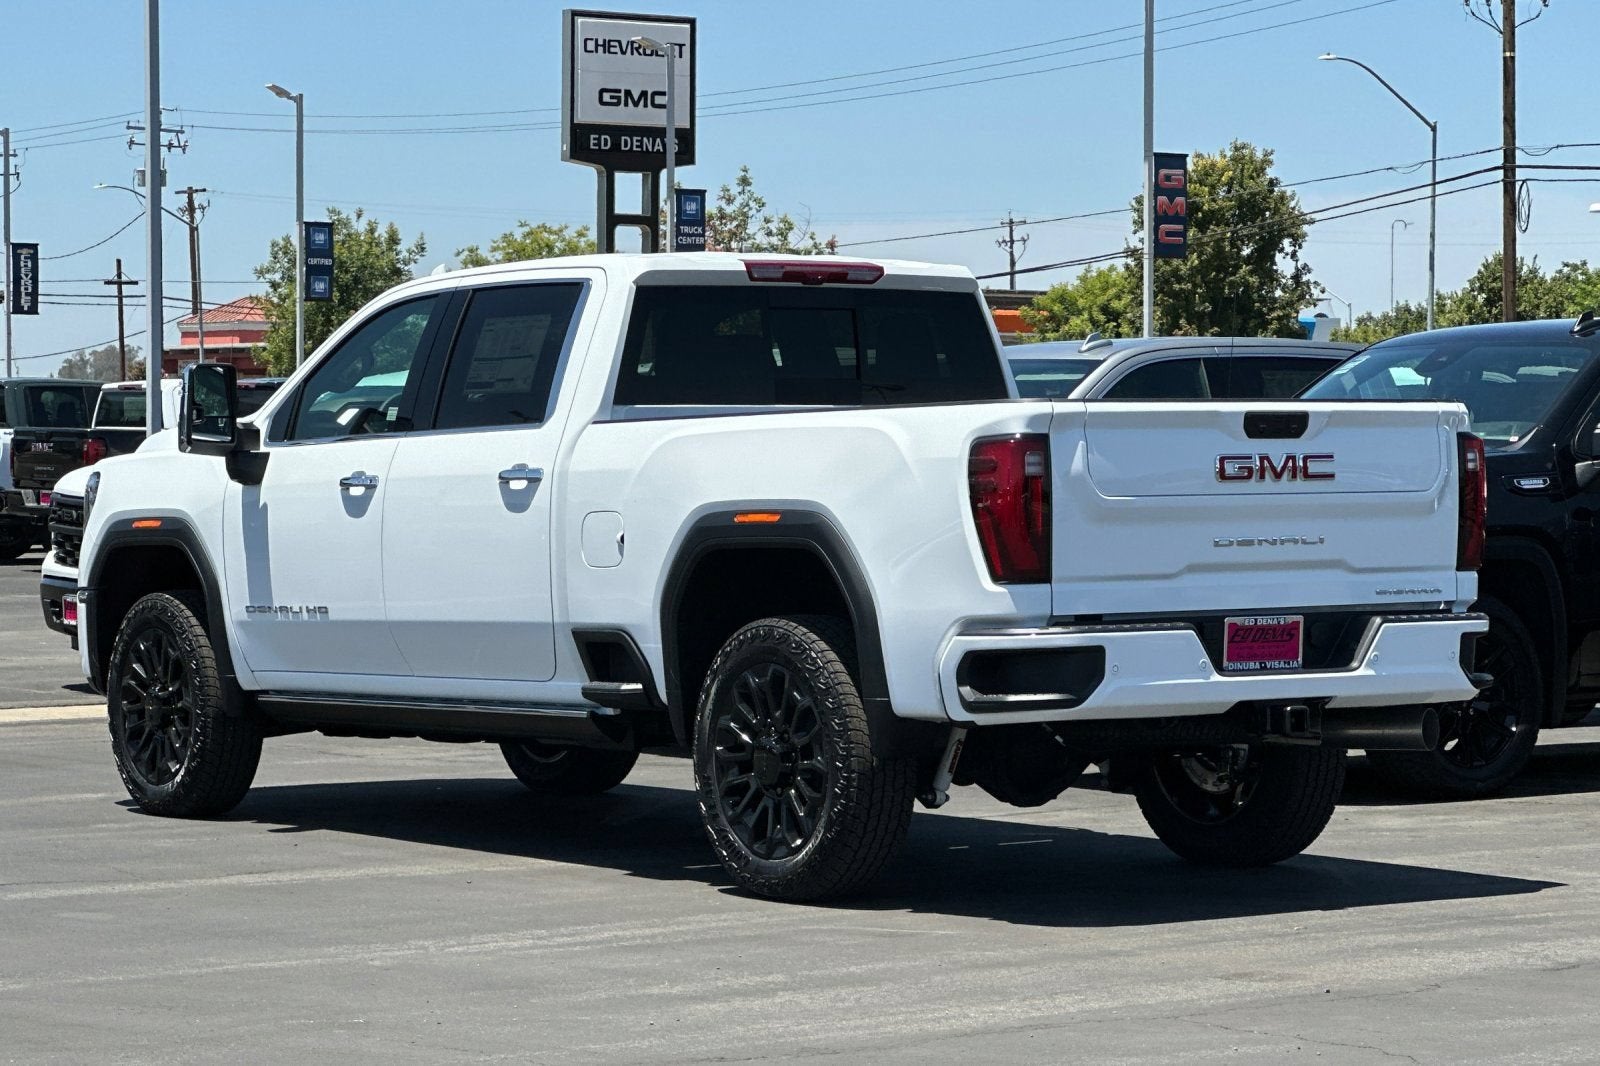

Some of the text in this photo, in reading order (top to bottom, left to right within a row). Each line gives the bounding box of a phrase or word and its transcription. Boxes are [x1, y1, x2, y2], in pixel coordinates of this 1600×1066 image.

[598, 87, 668, 109] GMC
[589, 134, 611, 150] ED
[1157, 168, 1186, 245] GMC
[679, 225, 703, 234] TRUCK
[677, 236, 705, 245] CENTER
[307, 257, 333, 266] CERTIFIED
[20, 254, 33, 311] CHEVROLET
[1214, 452, 1336, 483] GMC
[1213, 535, 1325, 548] DENALI
[245, 605, 329, 614] DENALI HD
[1257, 617, 1285, 625] DENA'S
[1228, 660, 1298, 670] DINUBA VISALIA
